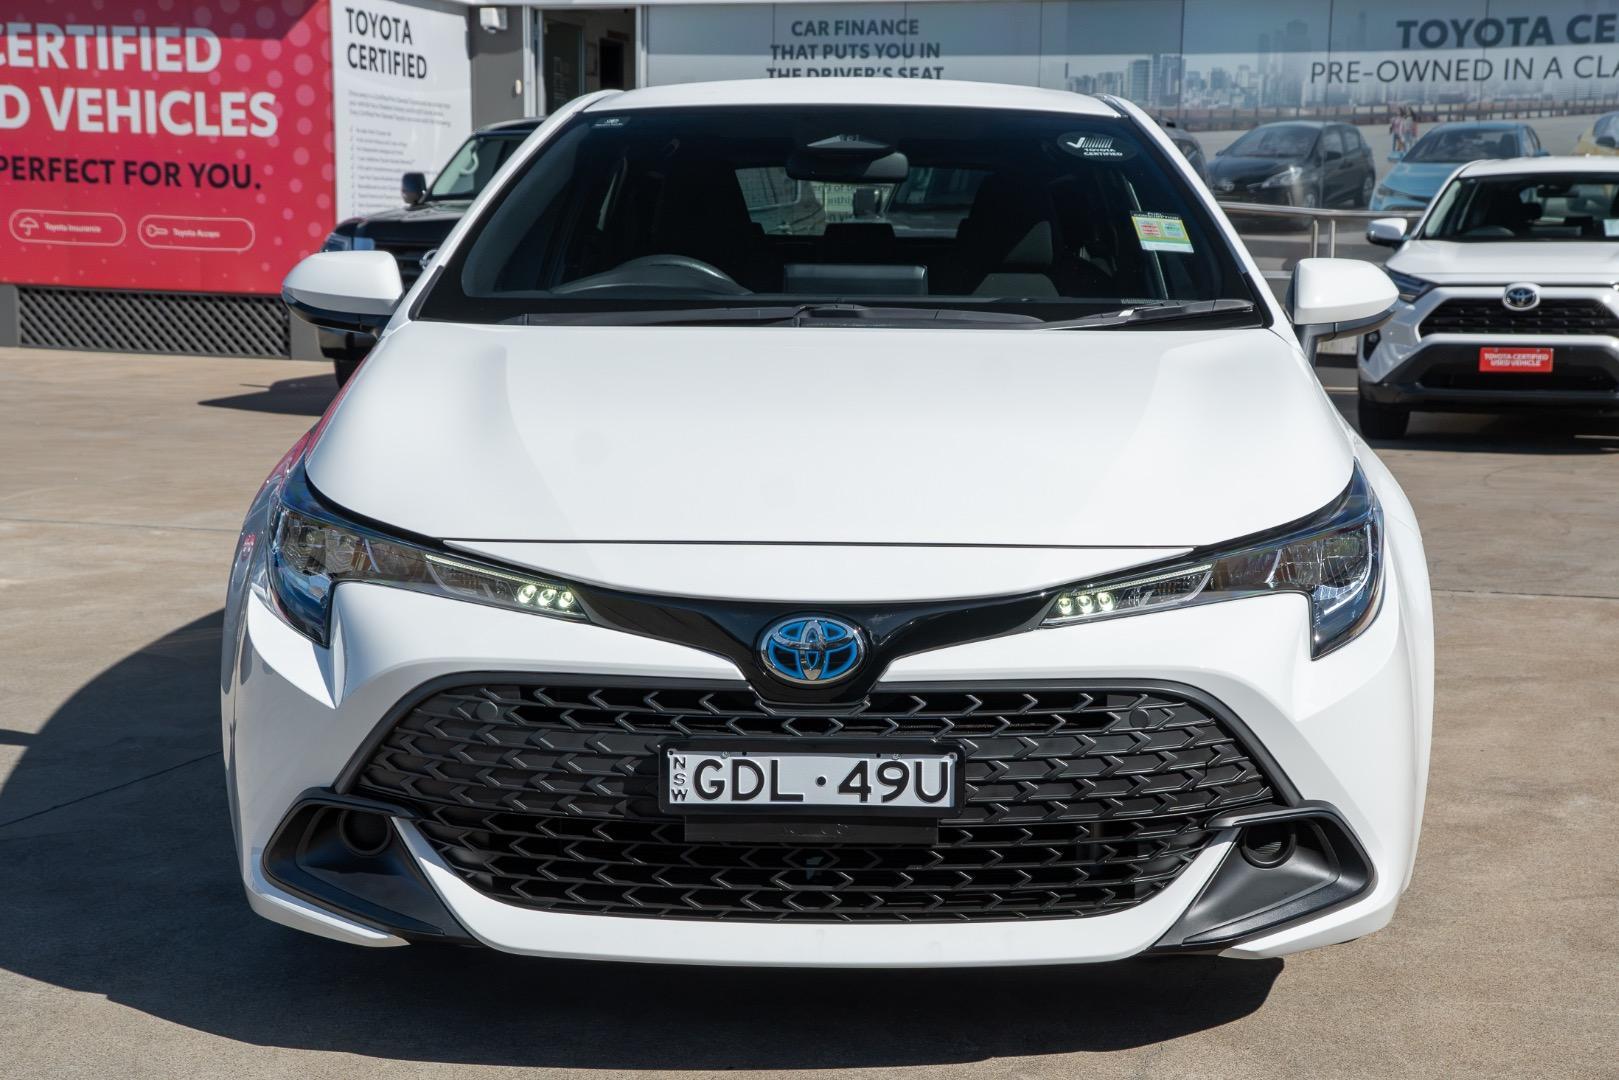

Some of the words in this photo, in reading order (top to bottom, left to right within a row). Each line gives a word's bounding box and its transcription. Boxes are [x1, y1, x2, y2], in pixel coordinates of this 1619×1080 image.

[346, 7, 413, 46] TOYOTA
[791, 20, 830, 36] CAR
[834, 19, 919, 36] FINANCE
[1396, 16, 1554, 49] TOYOTA
[1566, 14, 1617, 44] CE
[0, 22, 222, 73] ERTIFIED
[347, 42, 427, 79] CERTIFIED
[770, 44, 818, 60] THAT
[823, 43, 870, 59] PUTS
[875, 43, 915, 59] YOU
[920, 43, 940, 58] IN
[766, 68, 801, 79] THE
[898, 66, 944, 80] SEAT
[1311, 58, 1493, 84] PRE-OWNED
[1504, 57, 1534, 81] IN
[1543, 57, 1563, 80] A
[39, 86, 278, 137] VEHICLES
[123, 161, 181, 187] FOR
[188, 163, 261, 189] YOU.
